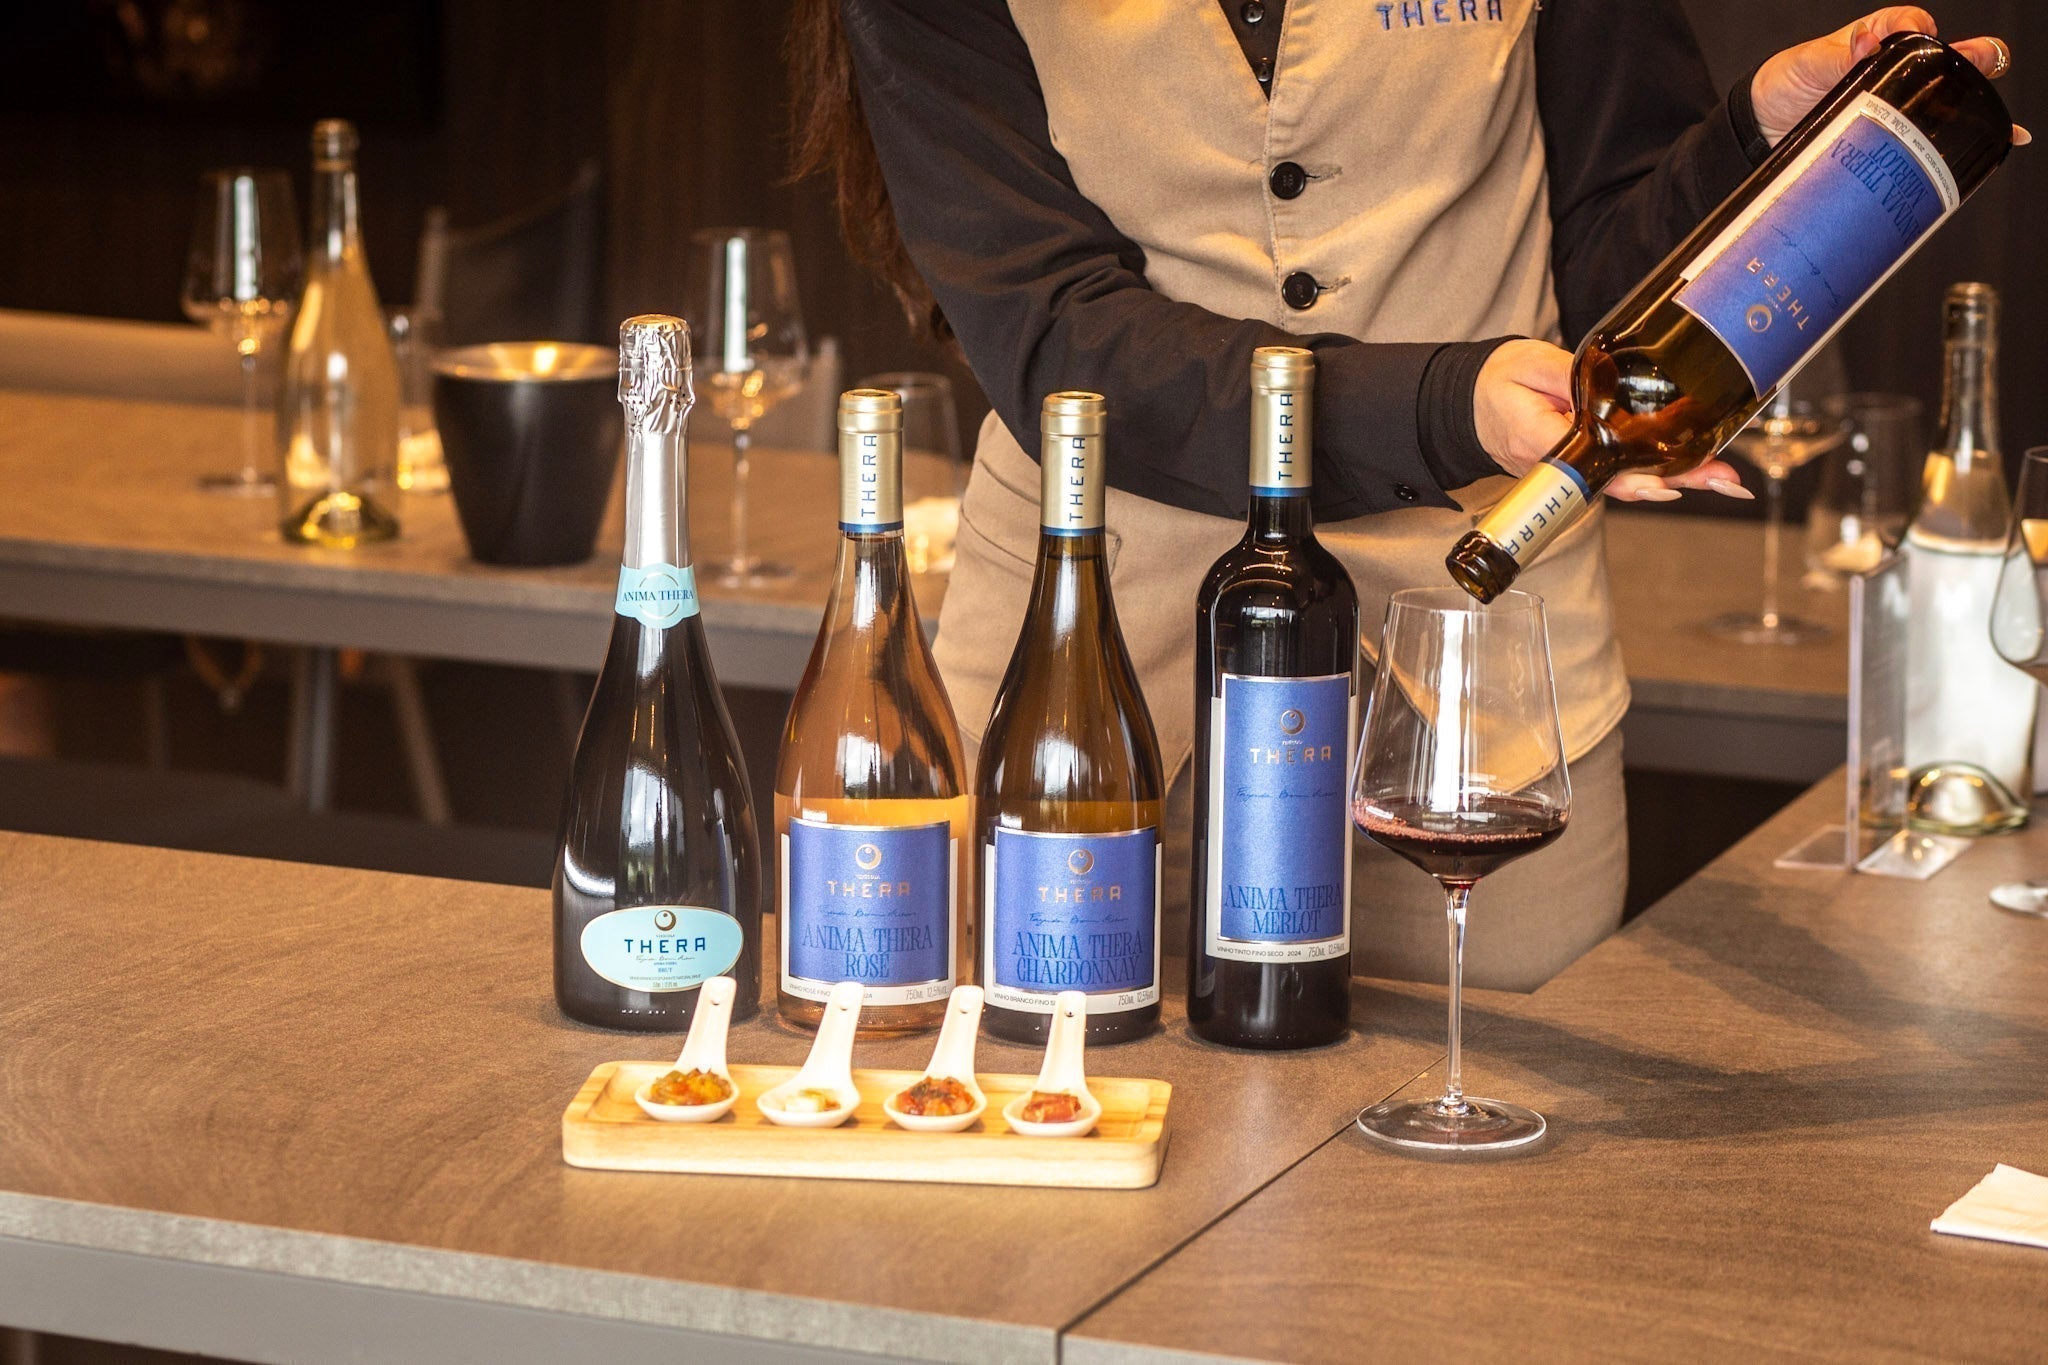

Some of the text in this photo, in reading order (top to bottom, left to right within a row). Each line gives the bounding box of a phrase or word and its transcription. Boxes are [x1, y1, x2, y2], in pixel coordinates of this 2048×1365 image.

[1375, 0, 1502, 30] THERA
[1829, 138, 1887, 194] THERA
[1868, 142, 1929, 209] MERLOT
[1746, 256, 1809, 330] THERA
[1278, 393, 1293, 481] THERA
[861, 435, 877, 517] THERA
[1069, 436, 1086, 522] THERA
[1504, 486, 1573, 557] THERA
[622, 589, 694, 602] ANIMA THERA
[1250, 745, 1331, 765] THERA
[828, 880, 910, 899] THERA
[1038, 884, 1121, 903] THERA
[1224, 884, 1343, 911] ANIMA THERA
[1252, 910, 1322, 935] MERLOT
[624, 937, 706, 954] THERA
[802, 924, 933, 953] ANIMA THERA
[1012, 930, 1144, 960] ANIMA THERA
[1016, 955, 1140, 985] CHARDONNAY
